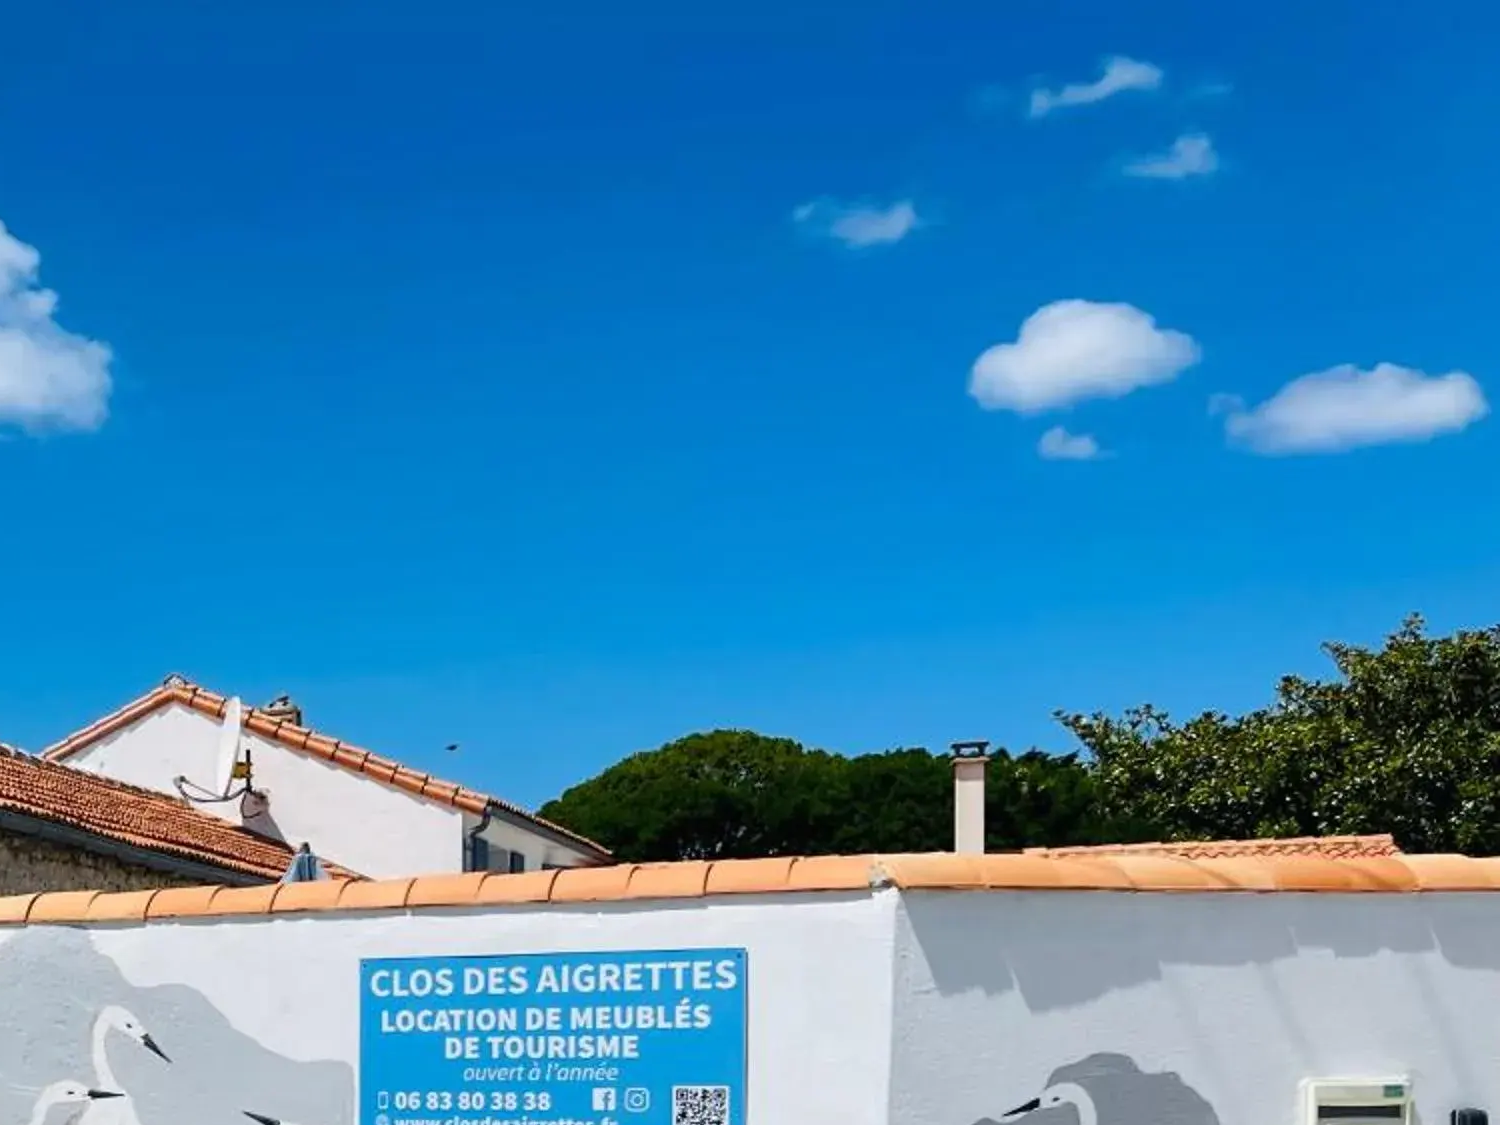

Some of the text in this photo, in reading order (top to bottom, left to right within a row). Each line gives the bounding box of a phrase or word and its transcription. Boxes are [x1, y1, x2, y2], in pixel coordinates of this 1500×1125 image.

[370, 960, 737, 997] CLOS DES AIGRETTES
[381, 998, 711, 1033] LOCATION DE MEUBLÉS
[445, 1035, 640, 1059] DE TOURISME
[463, 1061, 618, 1081] ouvert à l'année
[394, 1091, 551, 1110] 06 83 80 38 38
